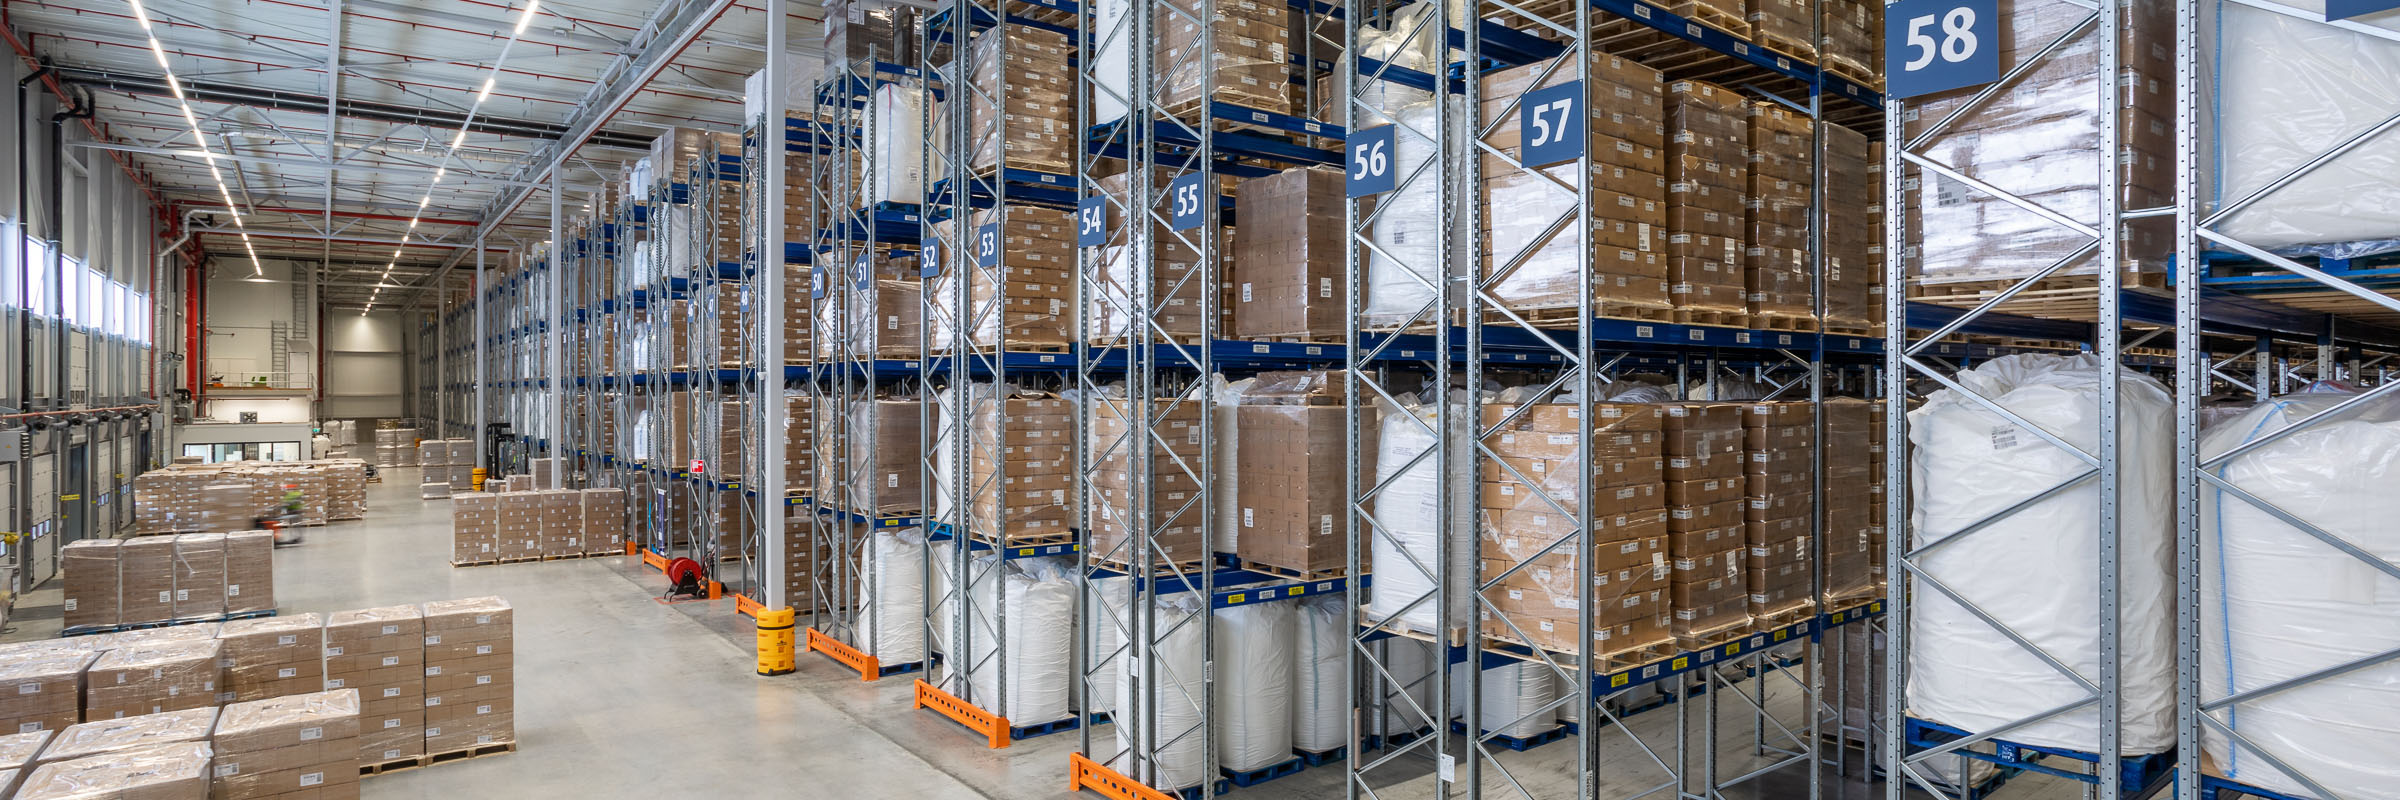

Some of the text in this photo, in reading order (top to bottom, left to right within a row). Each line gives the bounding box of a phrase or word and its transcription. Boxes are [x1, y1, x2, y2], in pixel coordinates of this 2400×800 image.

[1904, 6, 1979, 72] 58
[1531, 97, 1573, 146] 57
[1354, 139, 1387, 181] 56
[1177, 183, 1198, 217] 55
[1082, 205, 1103, 236] 54
[923, 245, 936, 269] 52
[982, 232, 995, 257] 53
[812, 272, 822, 292] 50
[858, 261, 867, 282] 51
